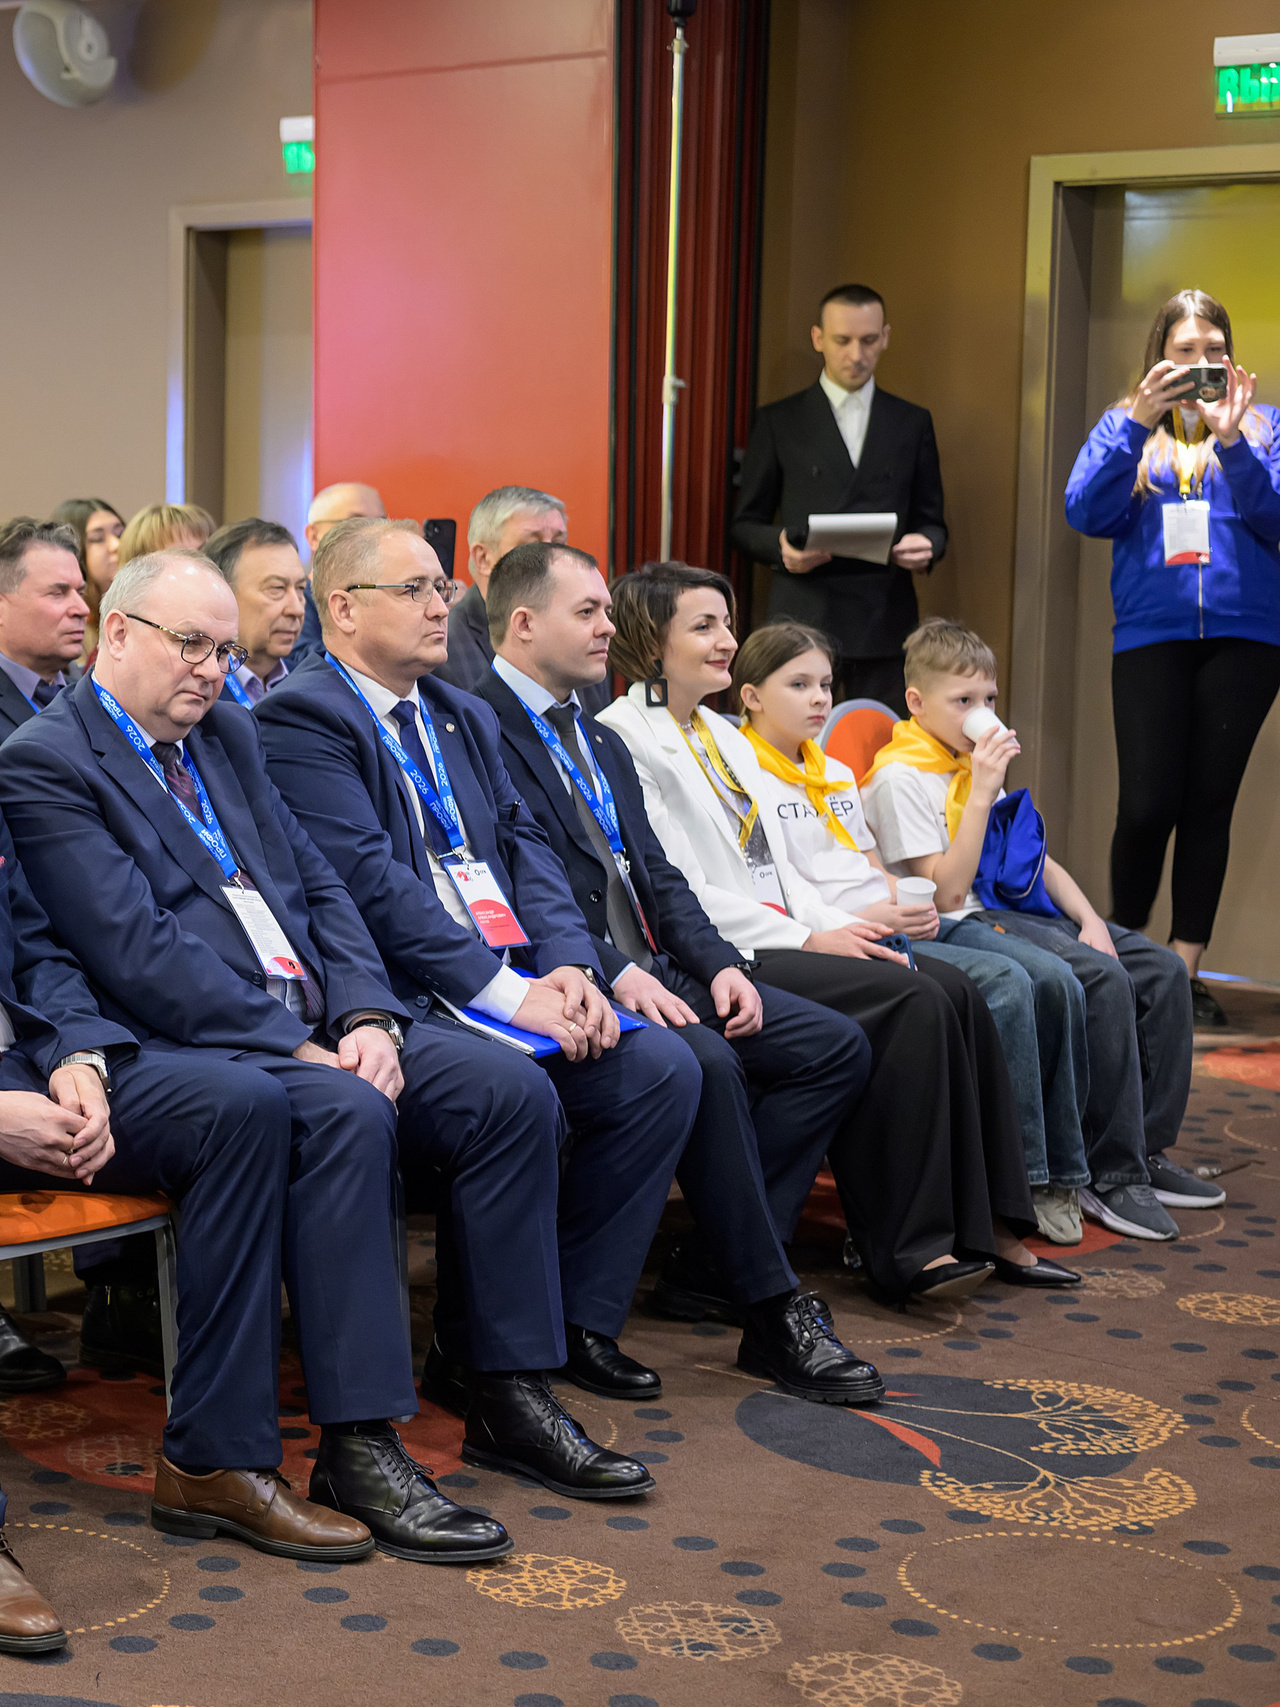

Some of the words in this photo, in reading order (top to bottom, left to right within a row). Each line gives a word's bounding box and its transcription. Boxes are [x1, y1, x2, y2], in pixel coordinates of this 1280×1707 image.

[100, 690, 124, 717] ПРОФИ
[125, 725, 146, 752] 2026
[532, 716, 549, 739] 2026
[382, 735, 406, 764] ПРОФИ
[552, 743, 574, 772] ПРОФИ
[409, 769, 429, 795] 2026
[437, 762, 449, 788] 2026
[576, 776, 593, 802] 2026
[201, 799, 214, 825] 2026
[429, 801, 451, 831] ПРОФИ
[447, 795, 458, 826] РОФИ
[593, 808, 612, 836] ПРОФИ
[199, 832, 222, 861] НАСТАВНИК
[201, 828, 227, 859] ПРОФИ
